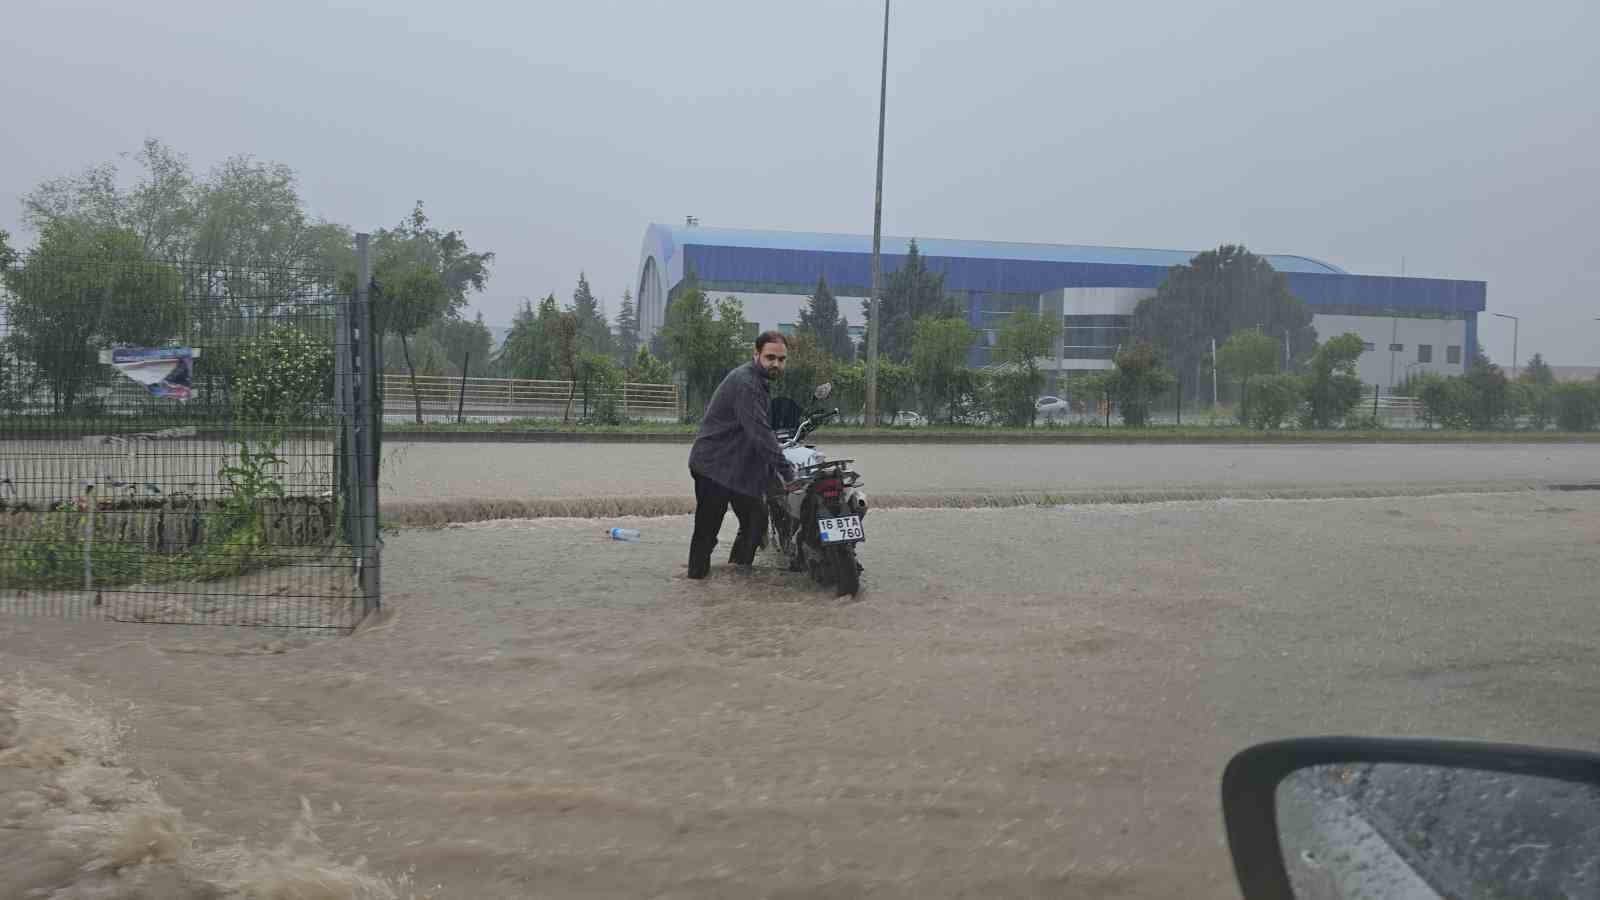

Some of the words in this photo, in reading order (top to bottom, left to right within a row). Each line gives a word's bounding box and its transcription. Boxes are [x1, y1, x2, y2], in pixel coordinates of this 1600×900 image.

[821, 520, 833, 530] 16
[837, 517, 858, 529] BTA
[840, 528, 861, 540] 760
